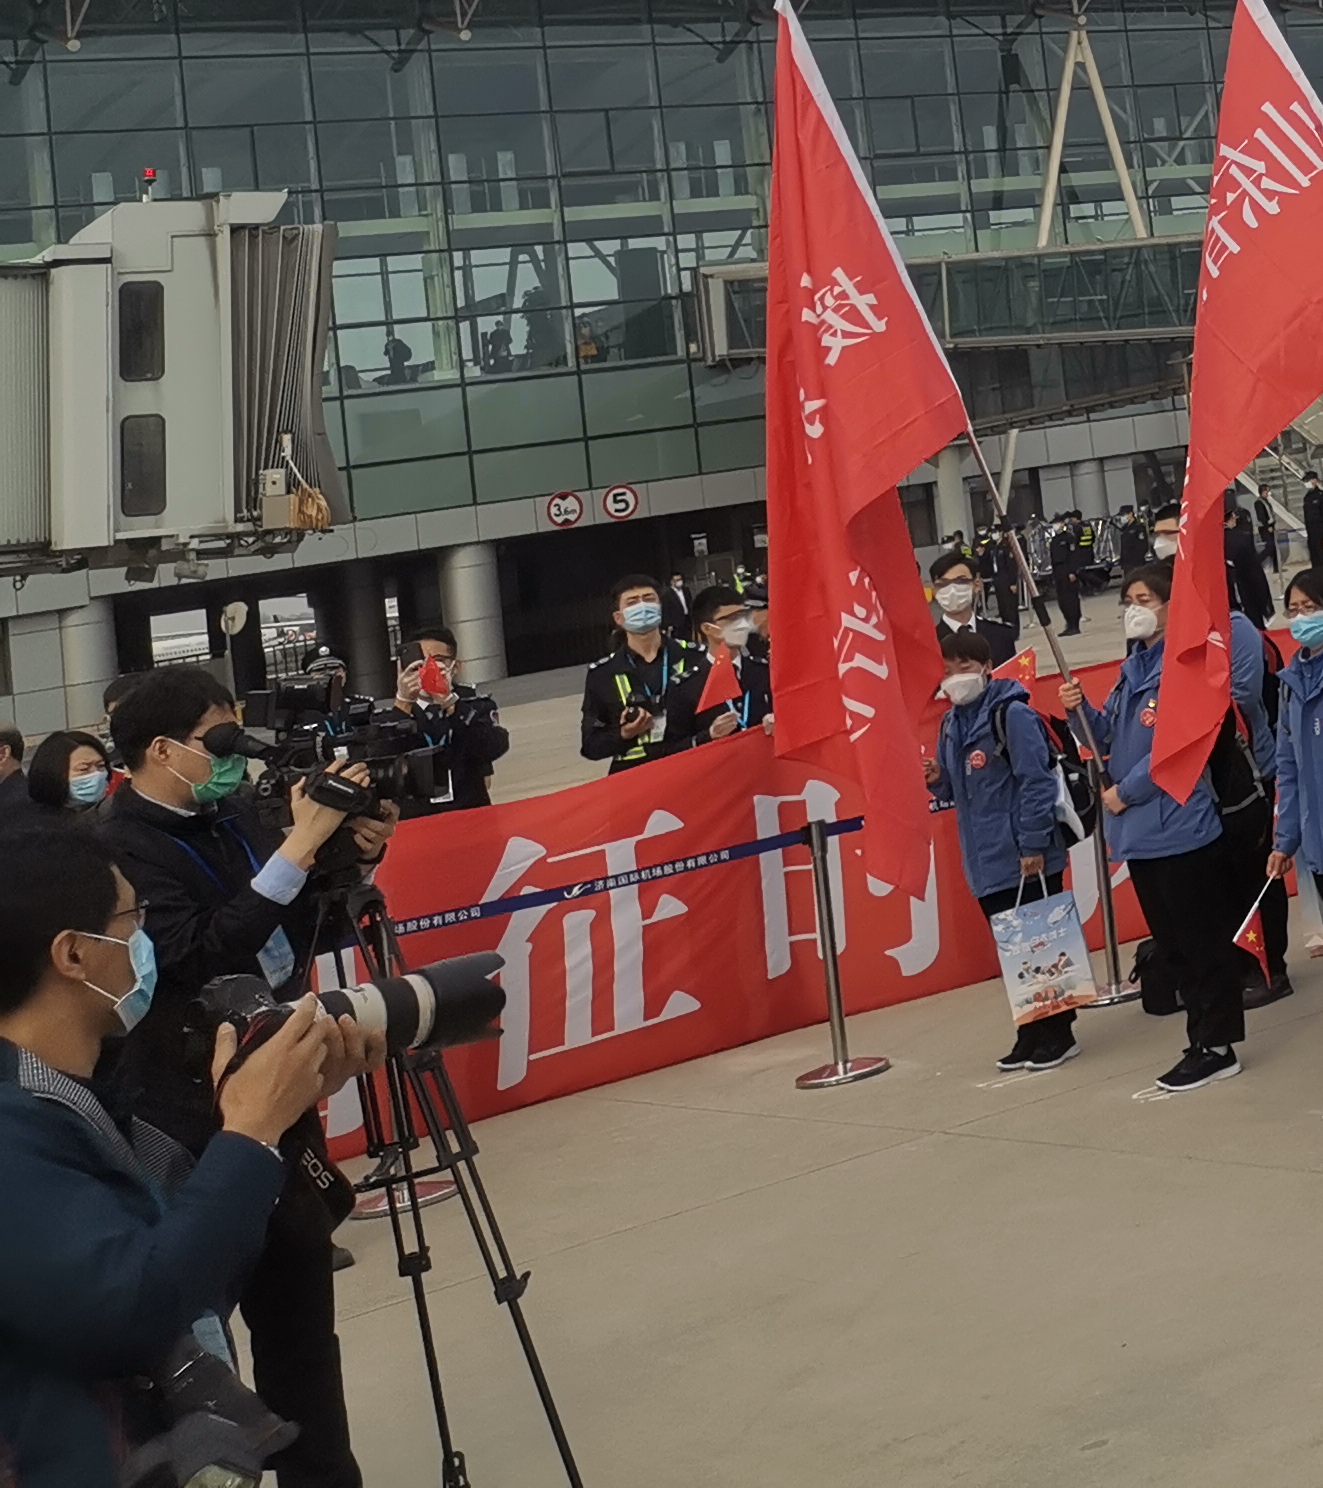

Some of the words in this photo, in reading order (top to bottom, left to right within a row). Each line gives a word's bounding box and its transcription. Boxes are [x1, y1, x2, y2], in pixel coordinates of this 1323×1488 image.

[553, 503, 578, 517] 3.6m
[612, 491, 630, 513] 5
[594, 849, 731, 892] 济南国际机场股份有限公司
[301, 1146, 334, 1189] EOS
